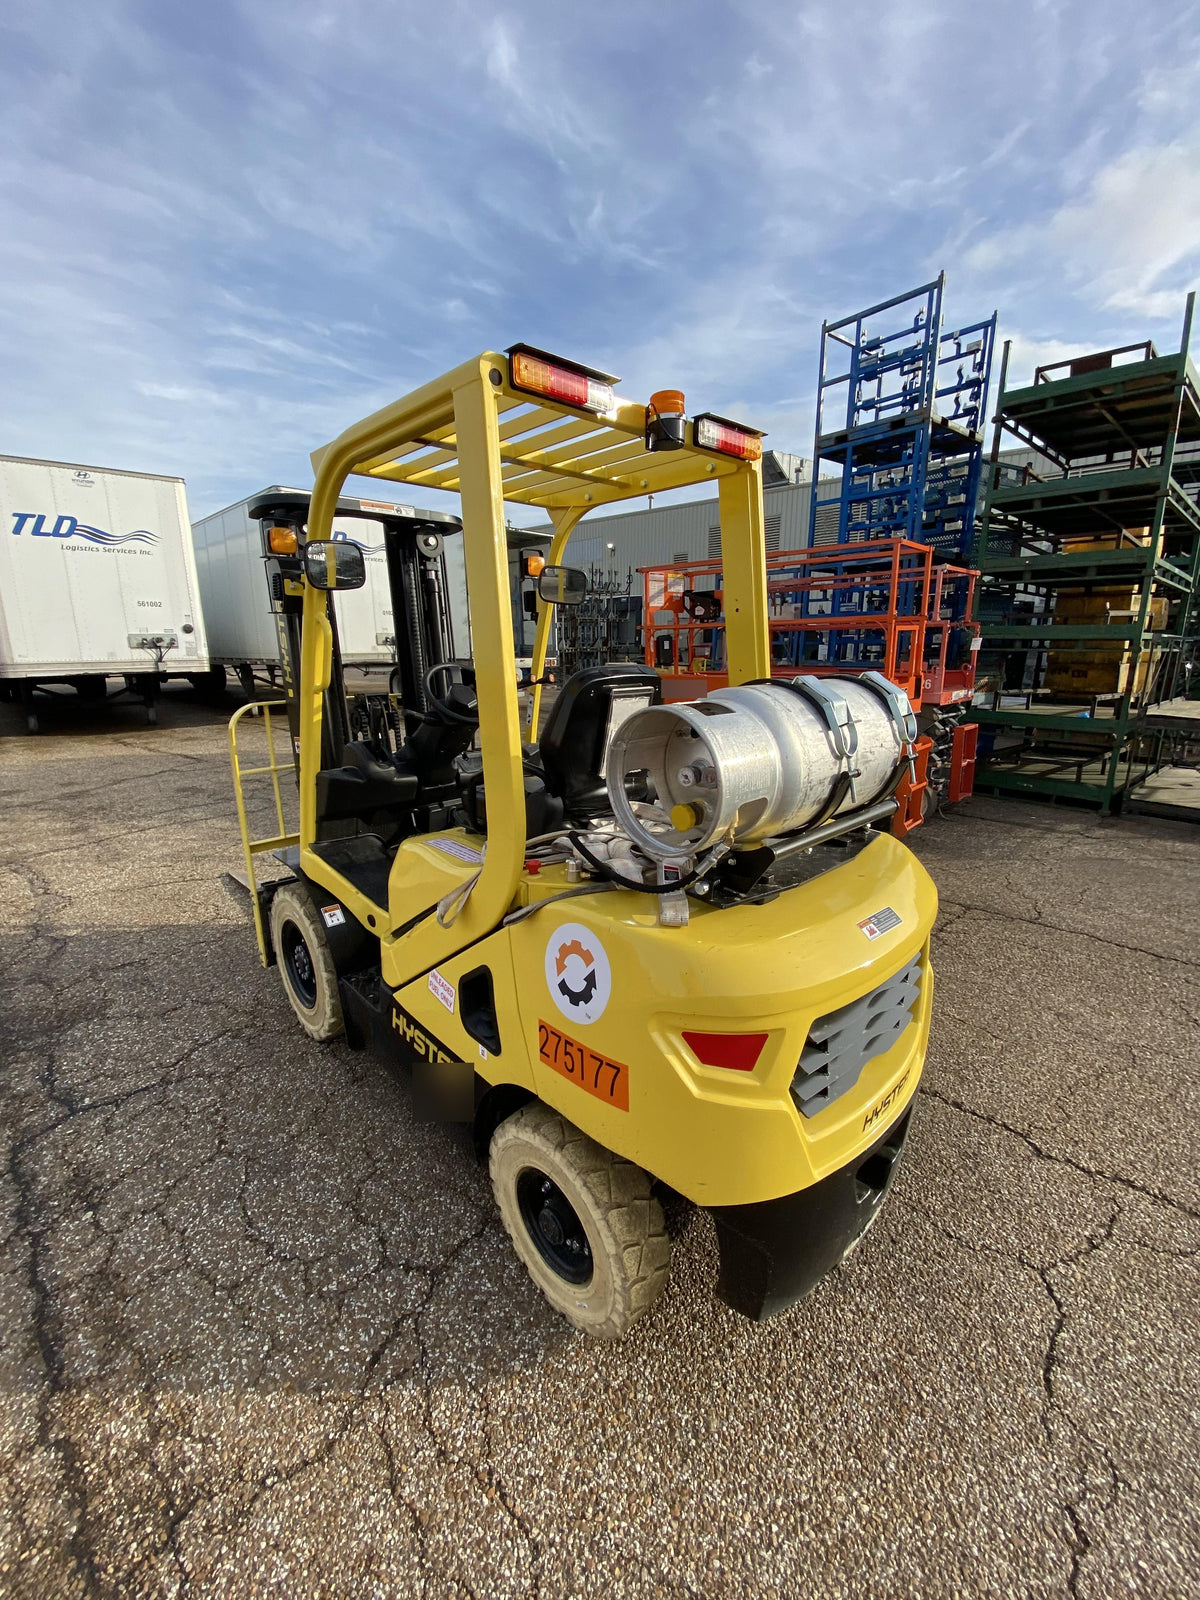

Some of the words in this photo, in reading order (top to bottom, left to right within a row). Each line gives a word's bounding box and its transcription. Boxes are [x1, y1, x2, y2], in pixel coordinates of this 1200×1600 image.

[12, 512, 78, 538] TLD
[60, 543, 100, 552] Logistics
[102, 546, 137, 555] Services
[139, 548, 154, 556] Inc.
[429, 980, 440, 996] FUEL
[538, 1024, 621, 1097] 275177
